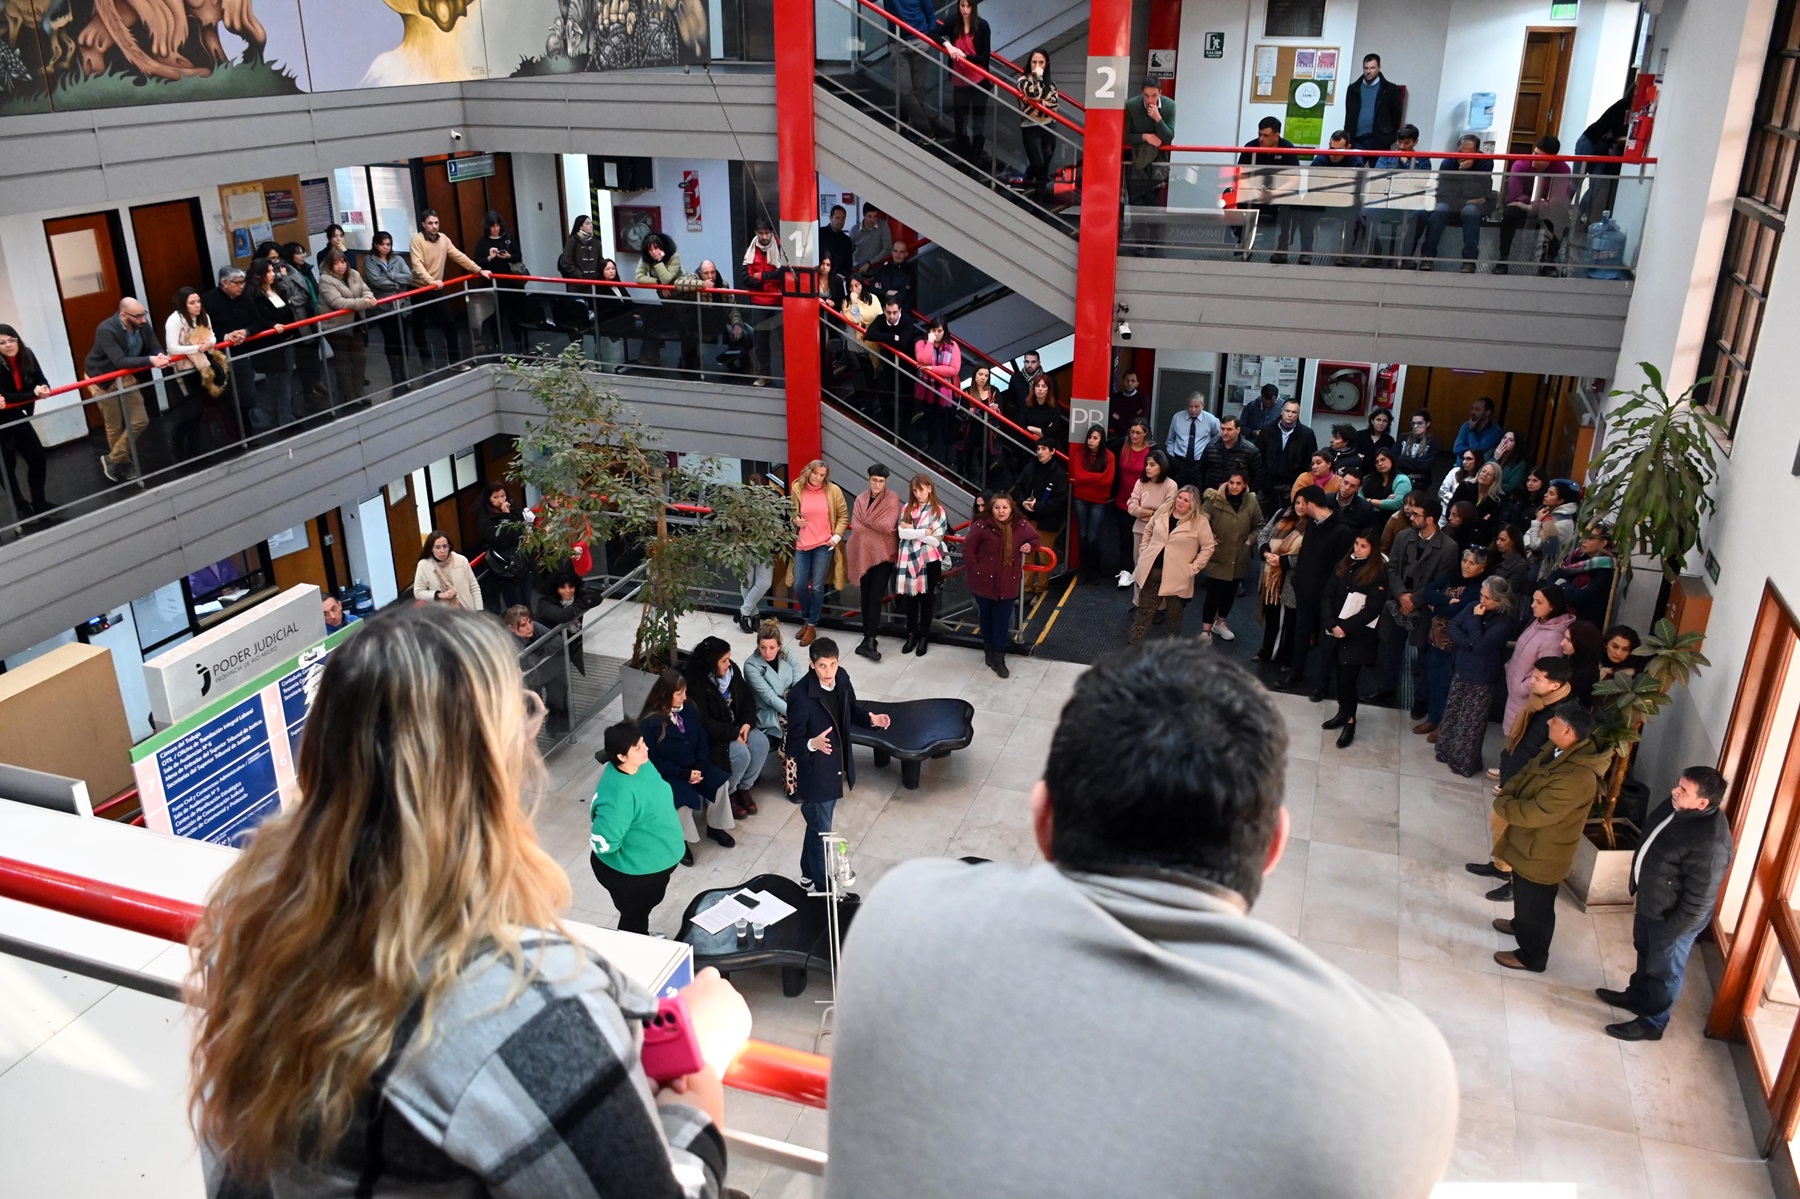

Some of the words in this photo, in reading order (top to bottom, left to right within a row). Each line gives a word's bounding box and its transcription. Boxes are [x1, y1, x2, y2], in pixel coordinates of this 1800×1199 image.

[1095, 66, 1116, 98] 2
[788, 230, 803, 257] 1
[213, 648, 252, 676] PODER
[253, 622, 300, 656] JUDICIAL
[215, 665, 243, 684] PROVINCIA
[244, 660, 251, 669] DE
[261, 645, 278, 659] NEGRO
[270, 704, 278, 717] 9
[160, 746, 178, 759] Cámara
[177, 740, 185, 748] del
[185, 732, 201, 744] Trabajo
[176, 745, 193, 757] Oficina
[199, 727, 223, 743] Tramitación
[223, 716, 239, 730] Integral
[238, 708, 254, 721] Laboral
[163, 765, 173, 775] Sala
[179, 747, 203, 765] Audiencias
[165, 771, 178, 782] Mesa
[184, 756, 203, 770] Entradas
[202, 751, 210, 760] del
[209, 742, 226, 757] Superior
[227, 729, 243, 743] Tribunal
[248, 720, 262, 731] Justicia
[197, 756, 214, 771] Superior
[214, 745, 231, 760] Tribunal
[237, 734, 251, 746] Justicia
[280, 753, 287, 767] 6
[146, 780, 155, 793] 7
[171, 802, 184, 813] Fuero
[183, 796, 192, 805] Civil
[195, 781, 219, 798] Contencioso
[219, 765, 245, 783] Administrativo
[173, 812, 183, 820] Sala
[188, 793, 211, 810] Audiencias
[174, 816, 189, 827] Centro
[196, 795, 221, 814] Planificación
[220, 781, 242, 797] Estratégica
[176, 819, 197, 834] Dirección
[202, 798, 231, 817] Comunicación
[230, 786, 245, 799] Judicial
[203, 806, 226, 824] Ceremonial
[229, 793, 248, 808] Protocolo
